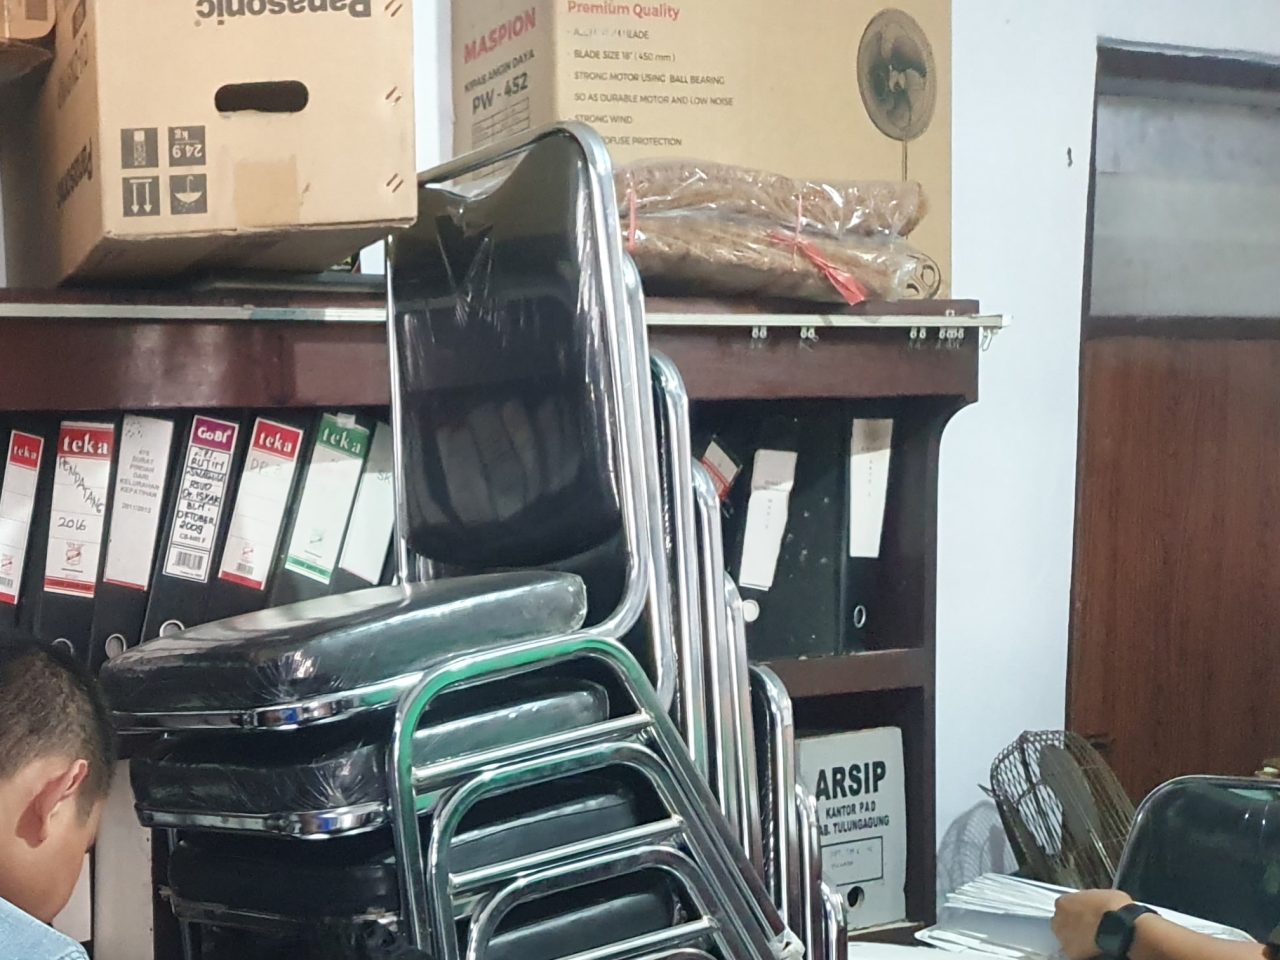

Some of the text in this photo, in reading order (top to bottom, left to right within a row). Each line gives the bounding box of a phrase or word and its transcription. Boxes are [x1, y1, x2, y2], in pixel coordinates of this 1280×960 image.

[568, 0, 680, 21] Premium Quality
[463, 7, 536, 64] MASPION
[574, 71, 608, 80] STRONG
[609, 72, 639, 82] MOTOR
[690, 75, 725, 85] BEARING
[472, 88, 495, 115] PW
[504, 72, 528, 97] 452
[600, 93, 638, 103] DURABLE
[640, 95, 670, 104] MOTOR
[671, 96, 688, 105] AND
[609, 115, 633, 124] WIND
[632, 137, 682, 146] PROTECTION
[63, 432, 108, 455] teka
[259, 432, 292, 452] teka
[322, 427, 361, 454] teka
[13, 445, 37, 460] teka
[57, 517, 87, 531] 2016
[816, 760, 887, 802] ARSIP
[826, 800, 876, 819] KANTOR PAD
[833, 814, 889, 834] TULUNGAGUNG
